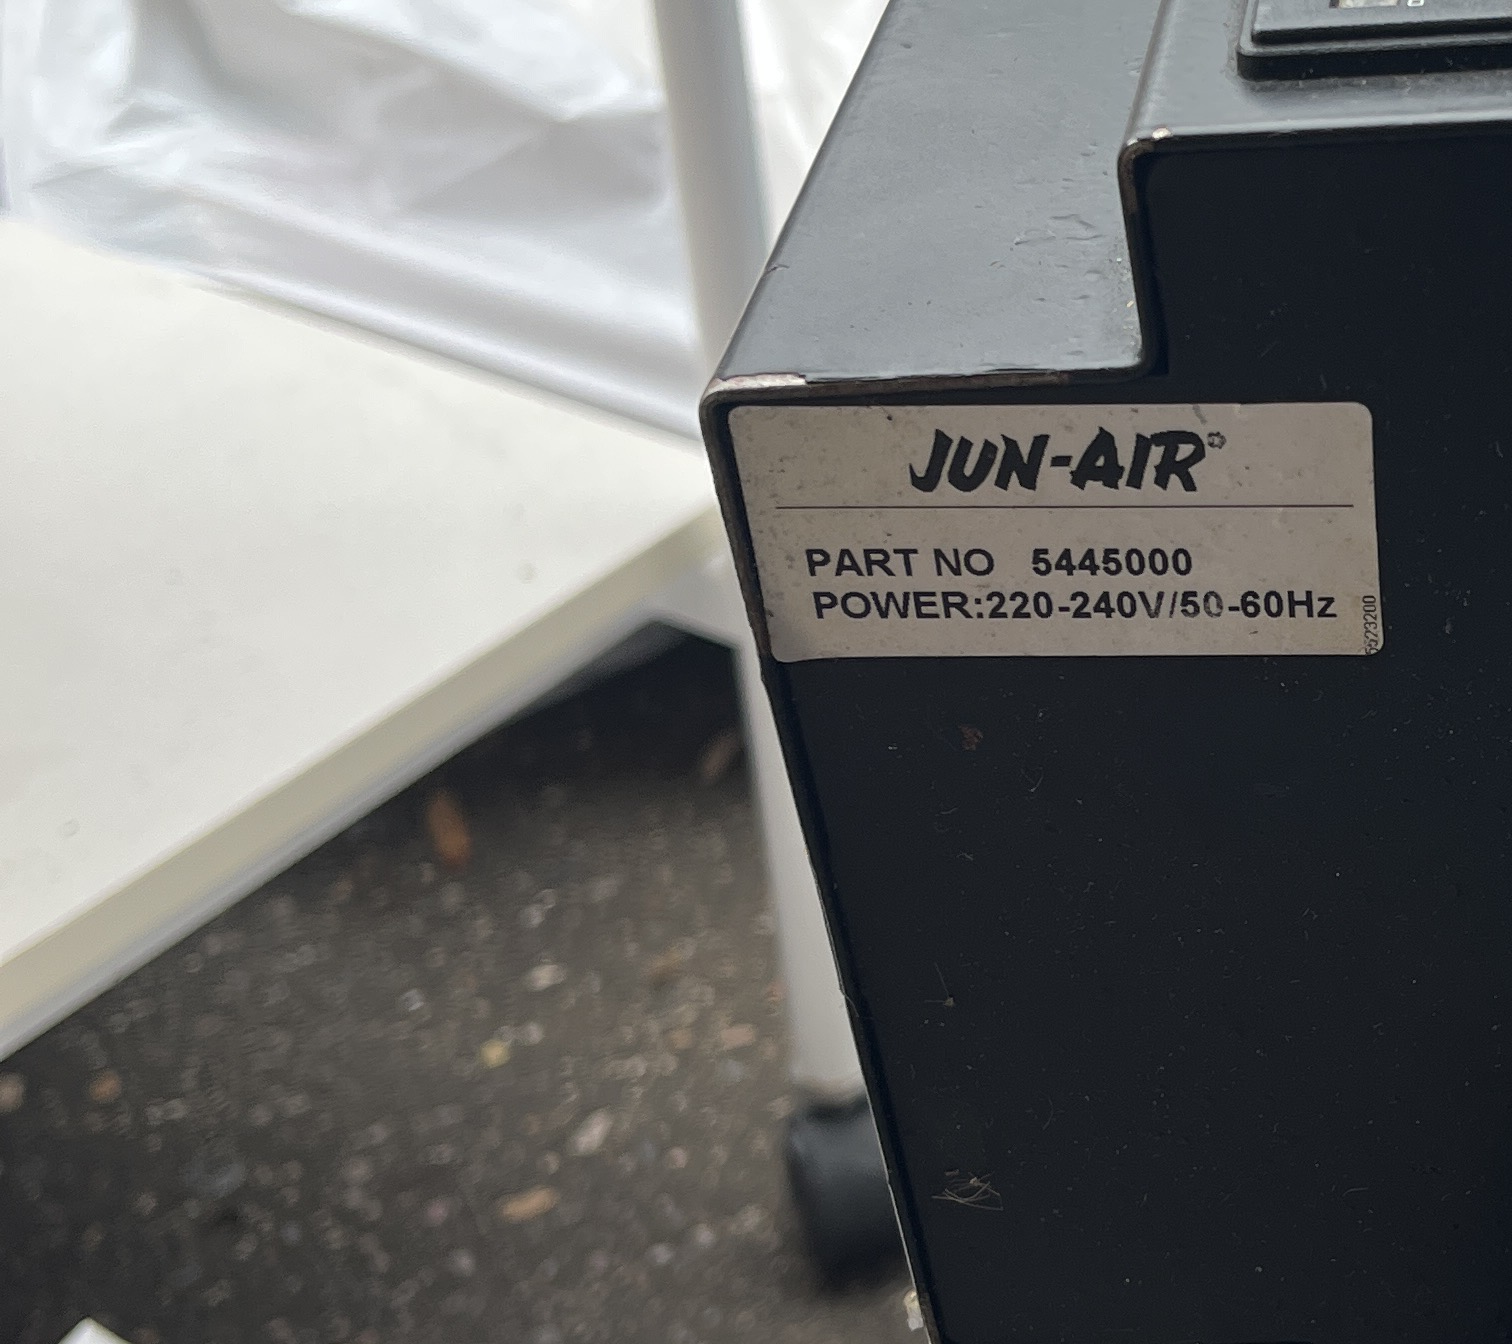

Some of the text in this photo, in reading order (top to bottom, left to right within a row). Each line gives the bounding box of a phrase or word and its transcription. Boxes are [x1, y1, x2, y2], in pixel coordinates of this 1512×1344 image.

[909, 427, 1205, 492] JUN-AIR
[806, 548, 1192, 576] PART NO 5445000
[813, 591, 1337, 619] POWER:220-240V/50-60Hz
